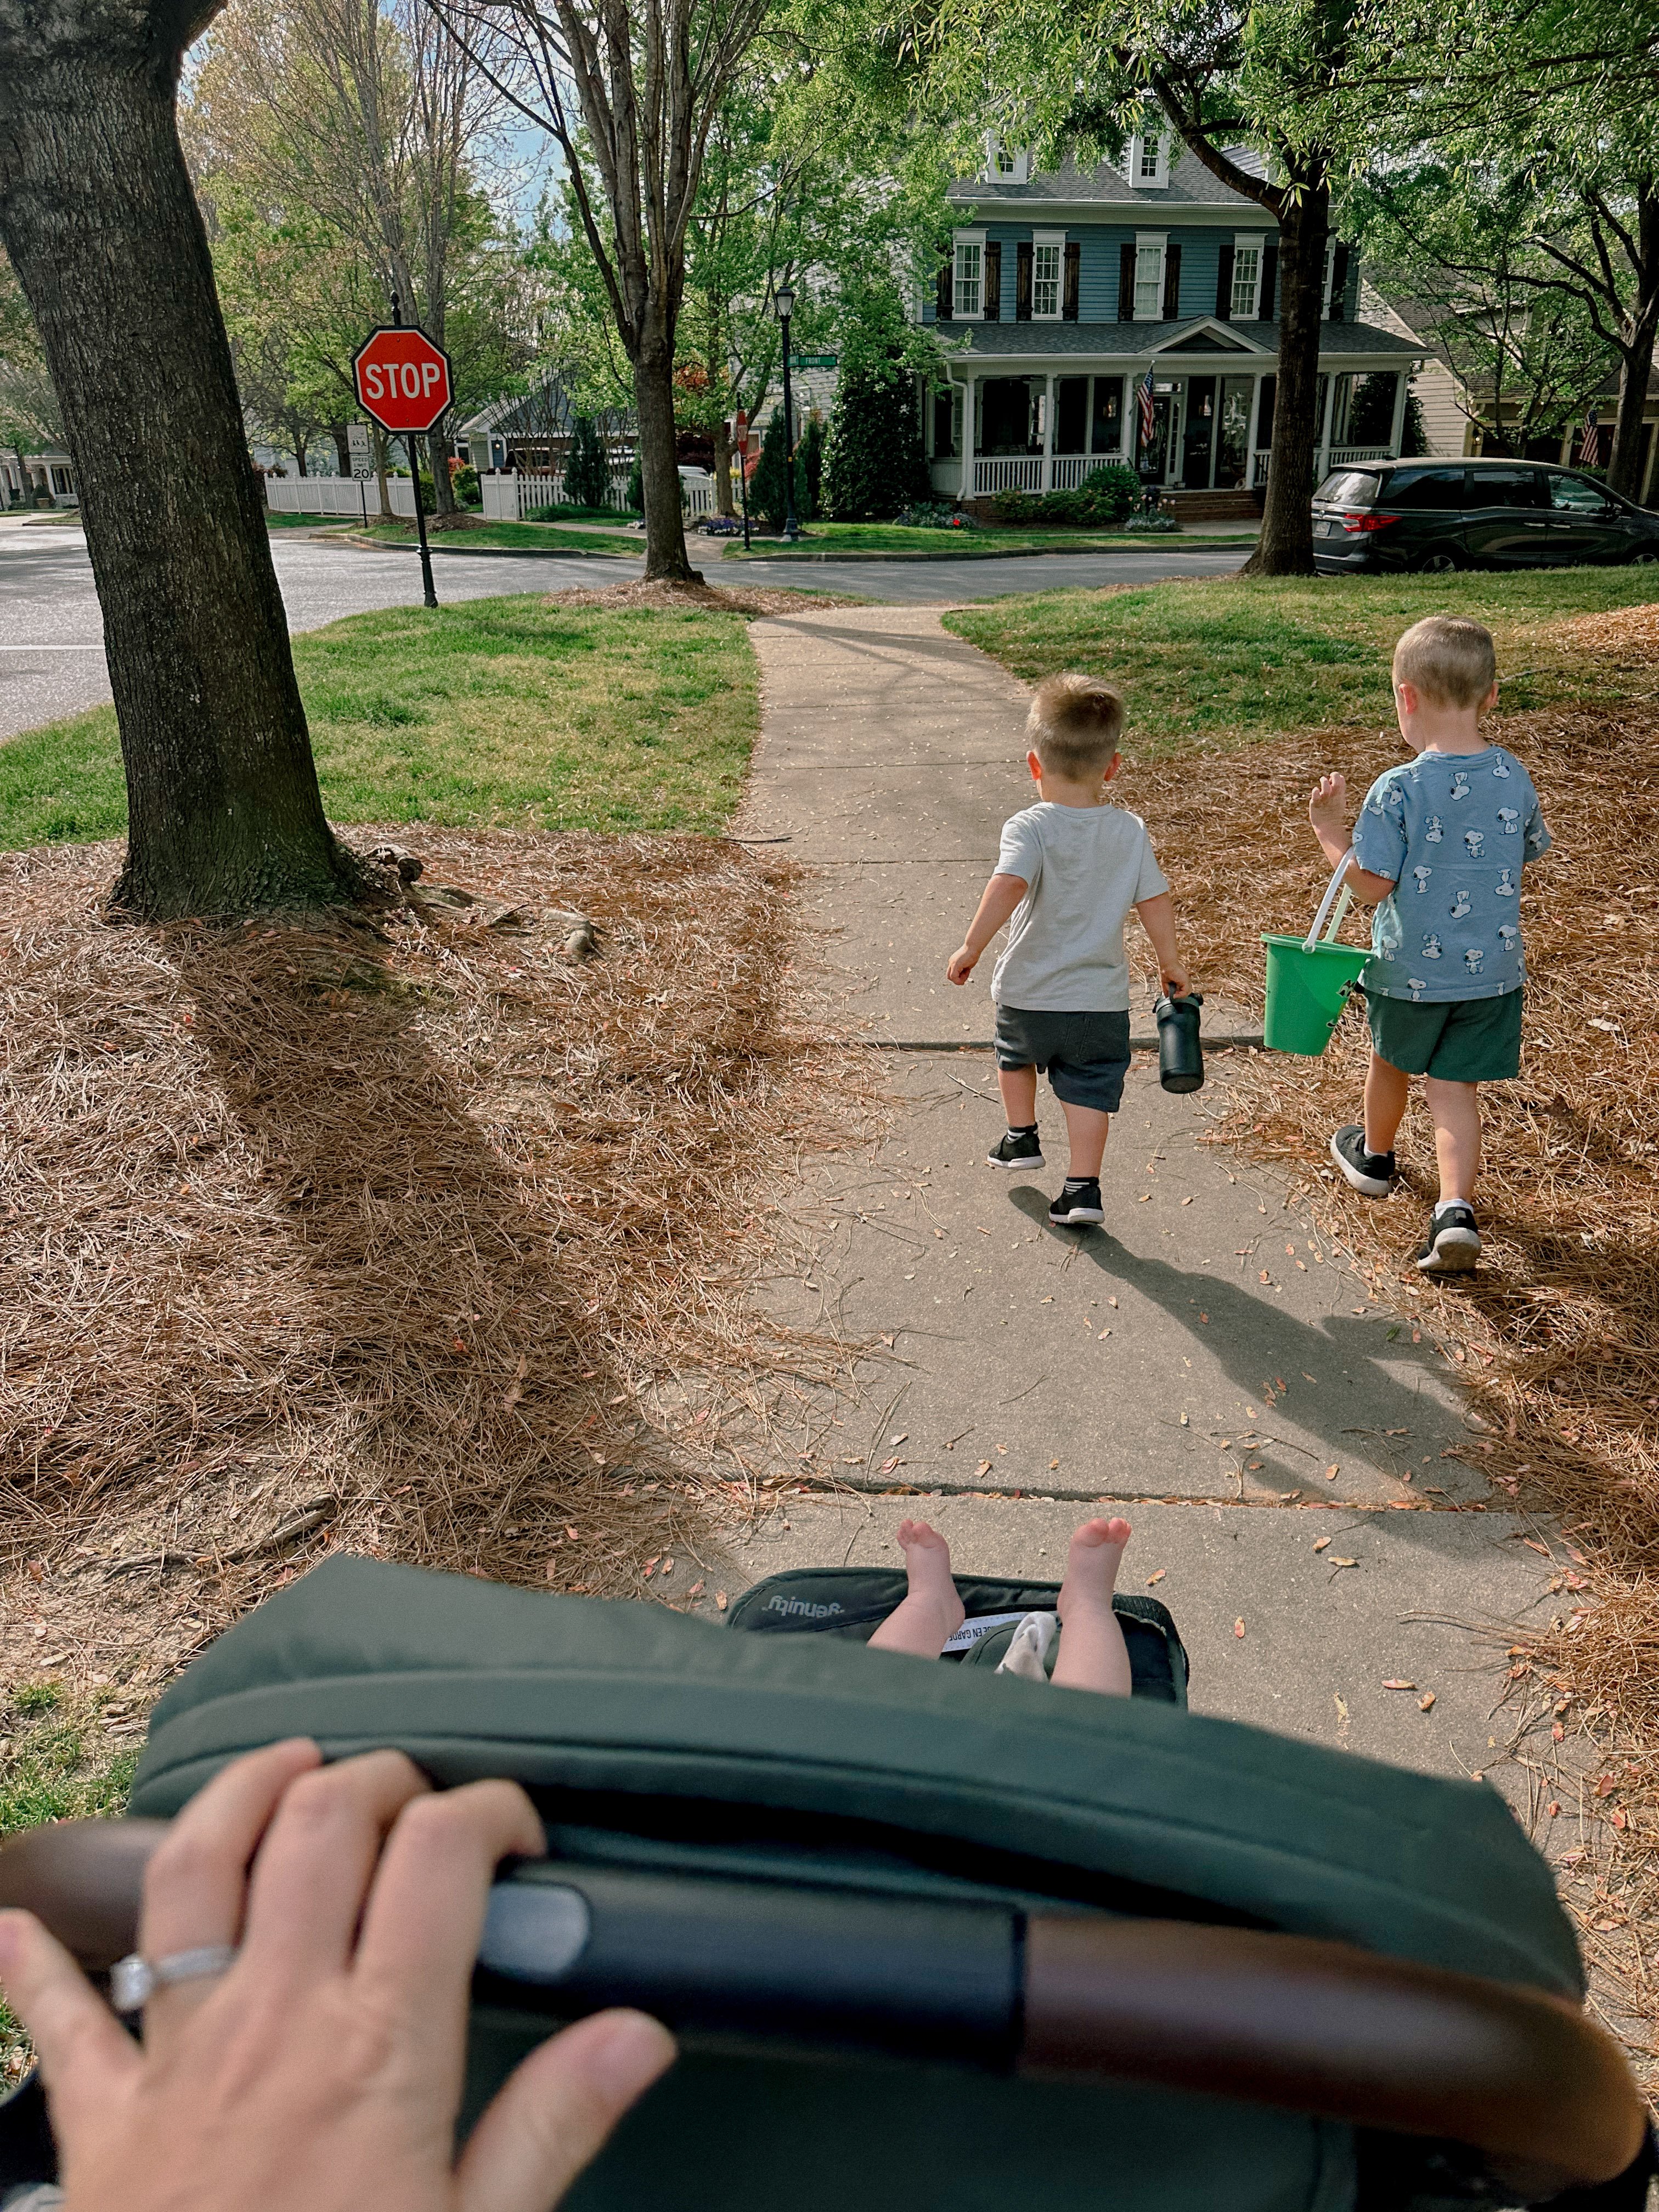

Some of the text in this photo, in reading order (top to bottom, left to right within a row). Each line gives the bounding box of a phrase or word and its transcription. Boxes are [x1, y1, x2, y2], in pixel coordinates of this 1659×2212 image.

[365, 363, 440, 399] STOP
[354, 469, 369, 478] 20
[768, 1595, 845, 1618] genuity
[973, 1627, 983, 1638] EN
